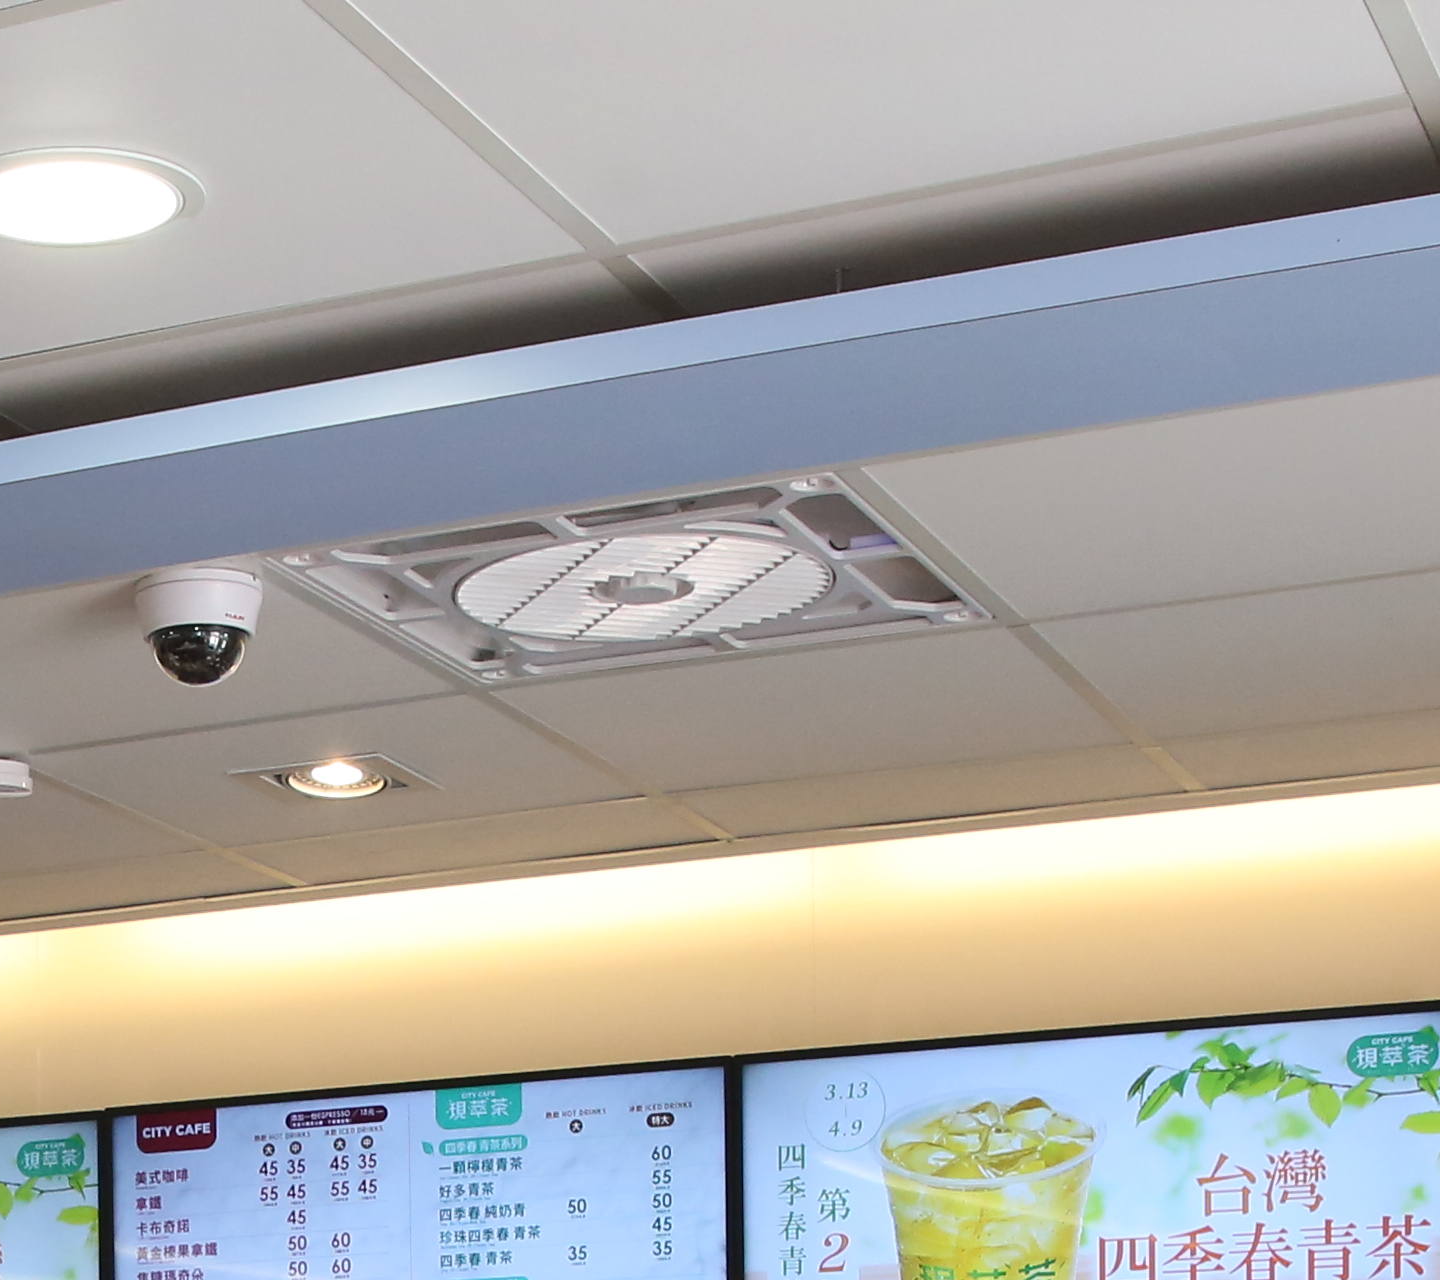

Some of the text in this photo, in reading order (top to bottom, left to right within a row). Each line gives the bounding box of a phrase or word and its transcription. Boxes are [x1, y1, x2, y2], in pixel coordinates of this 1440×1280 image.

[1354, 1044, 1432, 1070] 現萃茶
[825, 1082, 869, 1100] 3.13
[448, 1098, 509, 1120] 現萃茶
[650, 1115, 670, 1125] 特大
[828, 1120, 863, 1137] 4.9
[142, 1122, 211, 1139] CITY CAFE
[135, 1161, 278, 1185] 美式咖啡 45
[439, 1156, 523, 1175] 一顆檸檬青茶
[439, 1182, 494, 1198] 好多青茶
[1197, 1150, 1328, 1217] 台灣
[136, 1186, 278, 1210] 拿鐵 55
[568, 1199, 587, 1214] 50
[136, 1210, 306, 1236] 卡布奇諾 45
